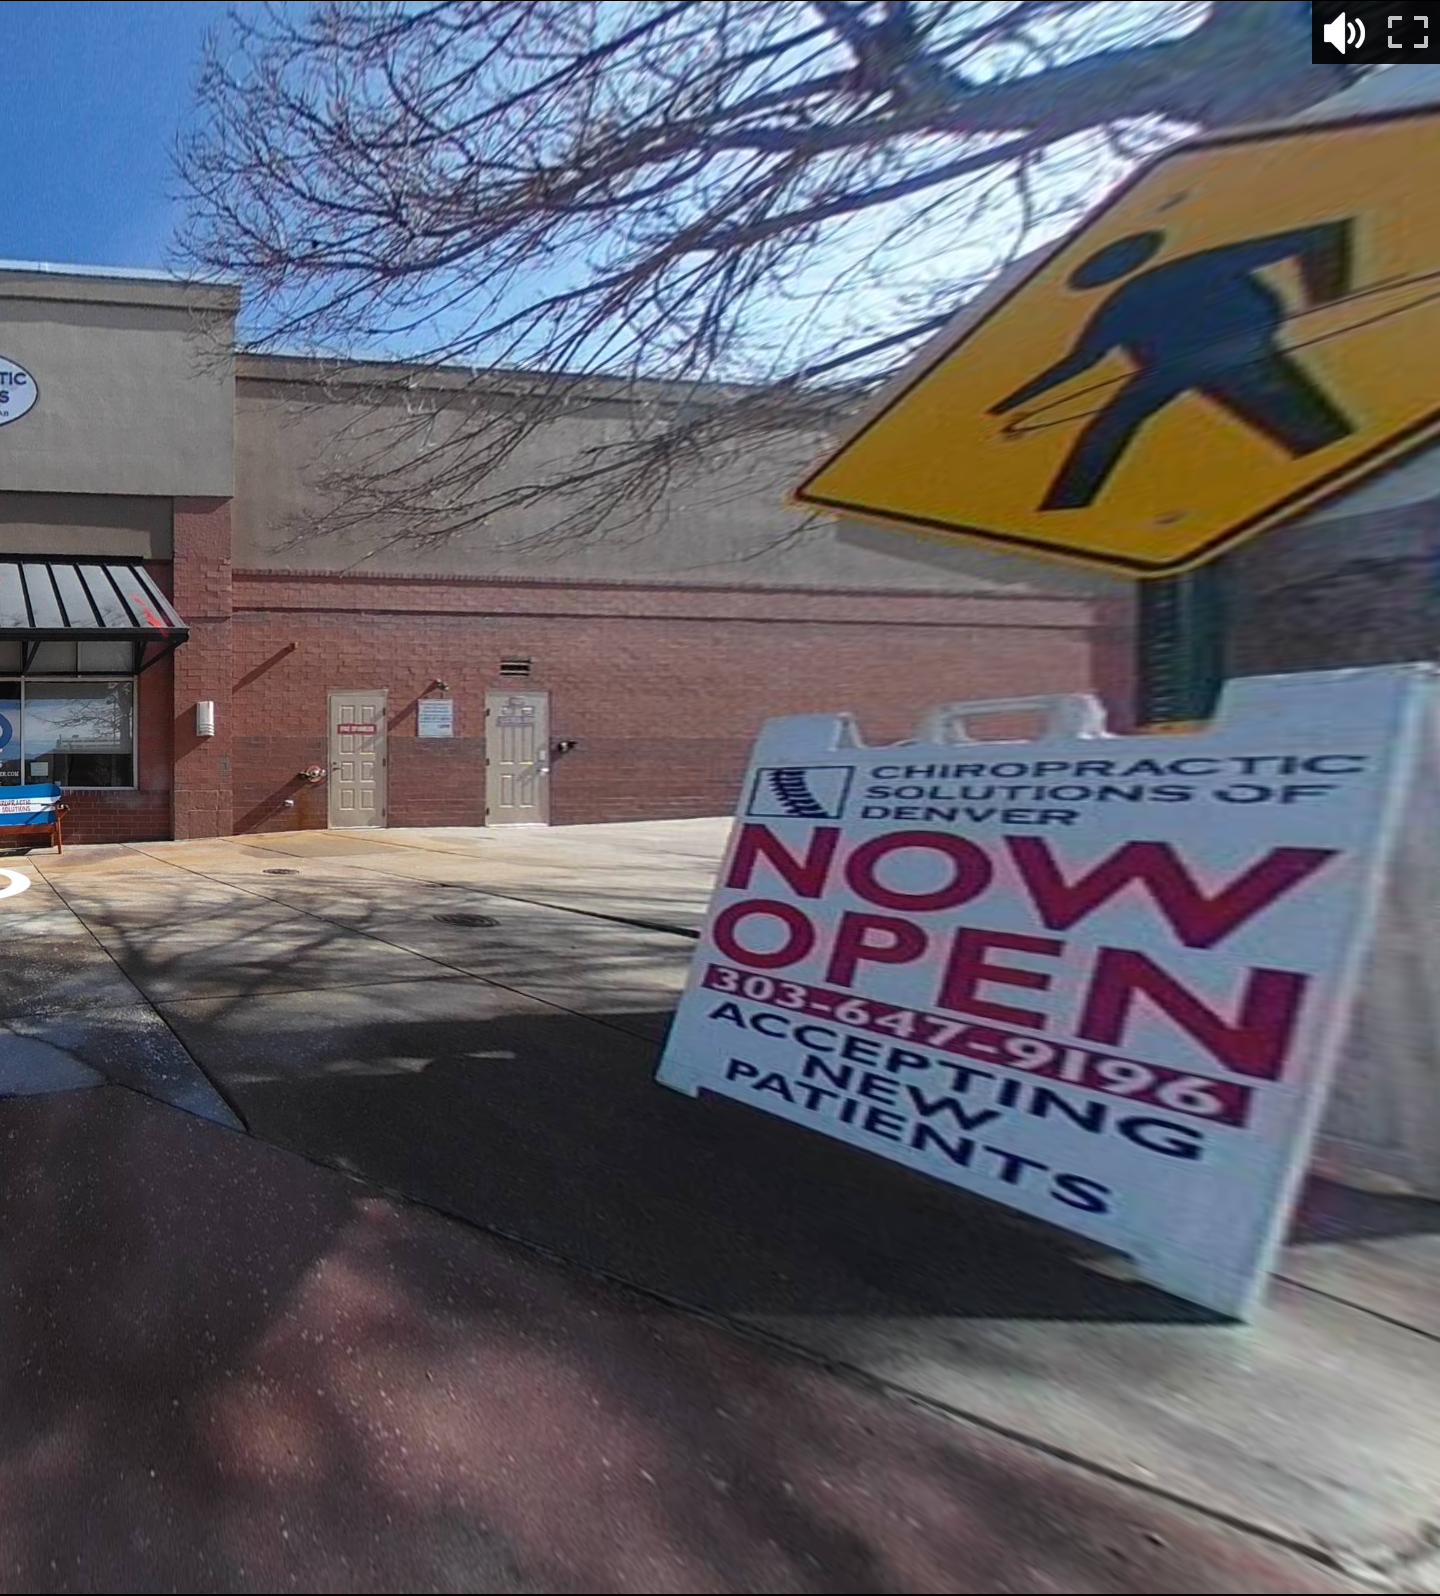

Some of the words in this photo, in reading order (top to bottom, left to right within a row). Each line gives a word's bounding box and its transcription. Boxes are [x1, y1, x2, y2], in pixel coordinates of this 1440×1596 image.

[860, 805, 1082, 827] DENVER
[863, 783, 1194, 803] SOLUTIONS
[1213, 783, 1344, 805] OF
[870, 755, 1371, 780] CHIROPRACTIC
[725, 822, 1340, 950] NOW
[709, 967, 1224, 1117] 303-647-9196
[712, 897, 1313, 1083] OPEN
[707, 1001, 1205, 1161] ACCEPTING
[725, 1058, 1113, 1215] PATIENTS
[802, 1055, 1002, 1133] NEW
